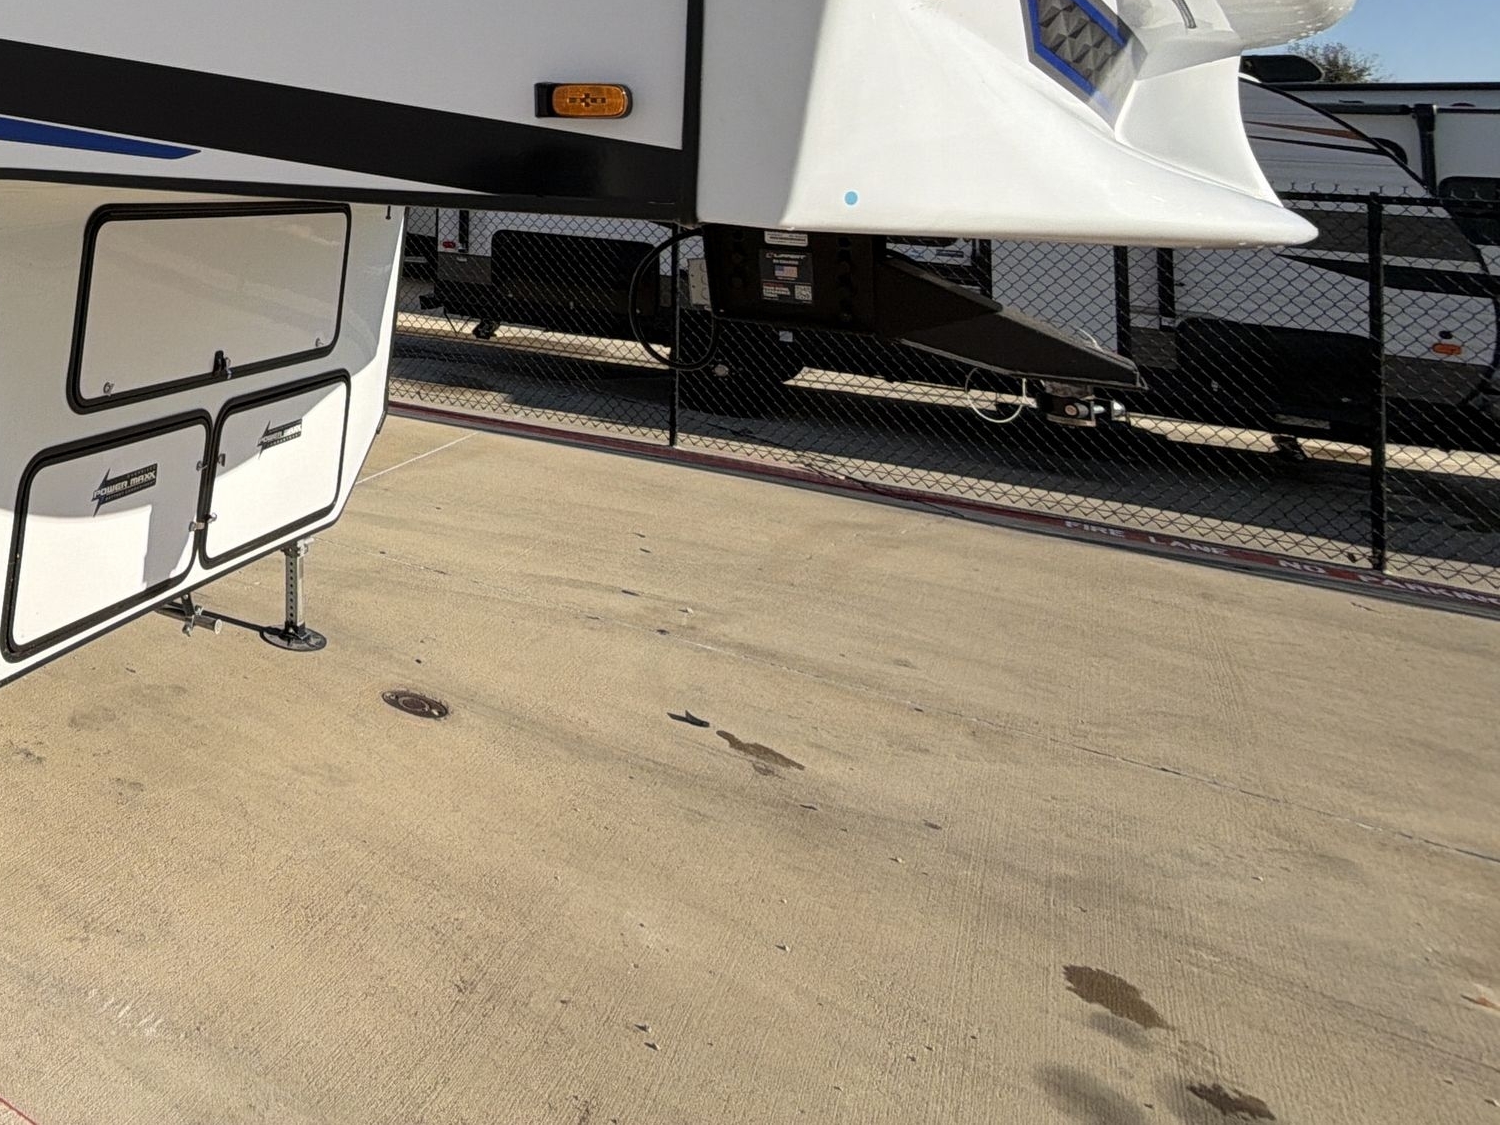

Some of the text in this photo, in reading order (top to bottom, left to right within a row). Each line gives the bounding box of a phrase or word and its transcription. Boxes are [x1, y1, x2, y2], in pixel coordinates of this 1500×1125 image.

[93, 470, 156, 499] POWER MAXX
[1065, 520, 1127, 538] FIRE
[1148, 535, 1230, 557] LANE
[1279, 559, 1328, 574] NO
